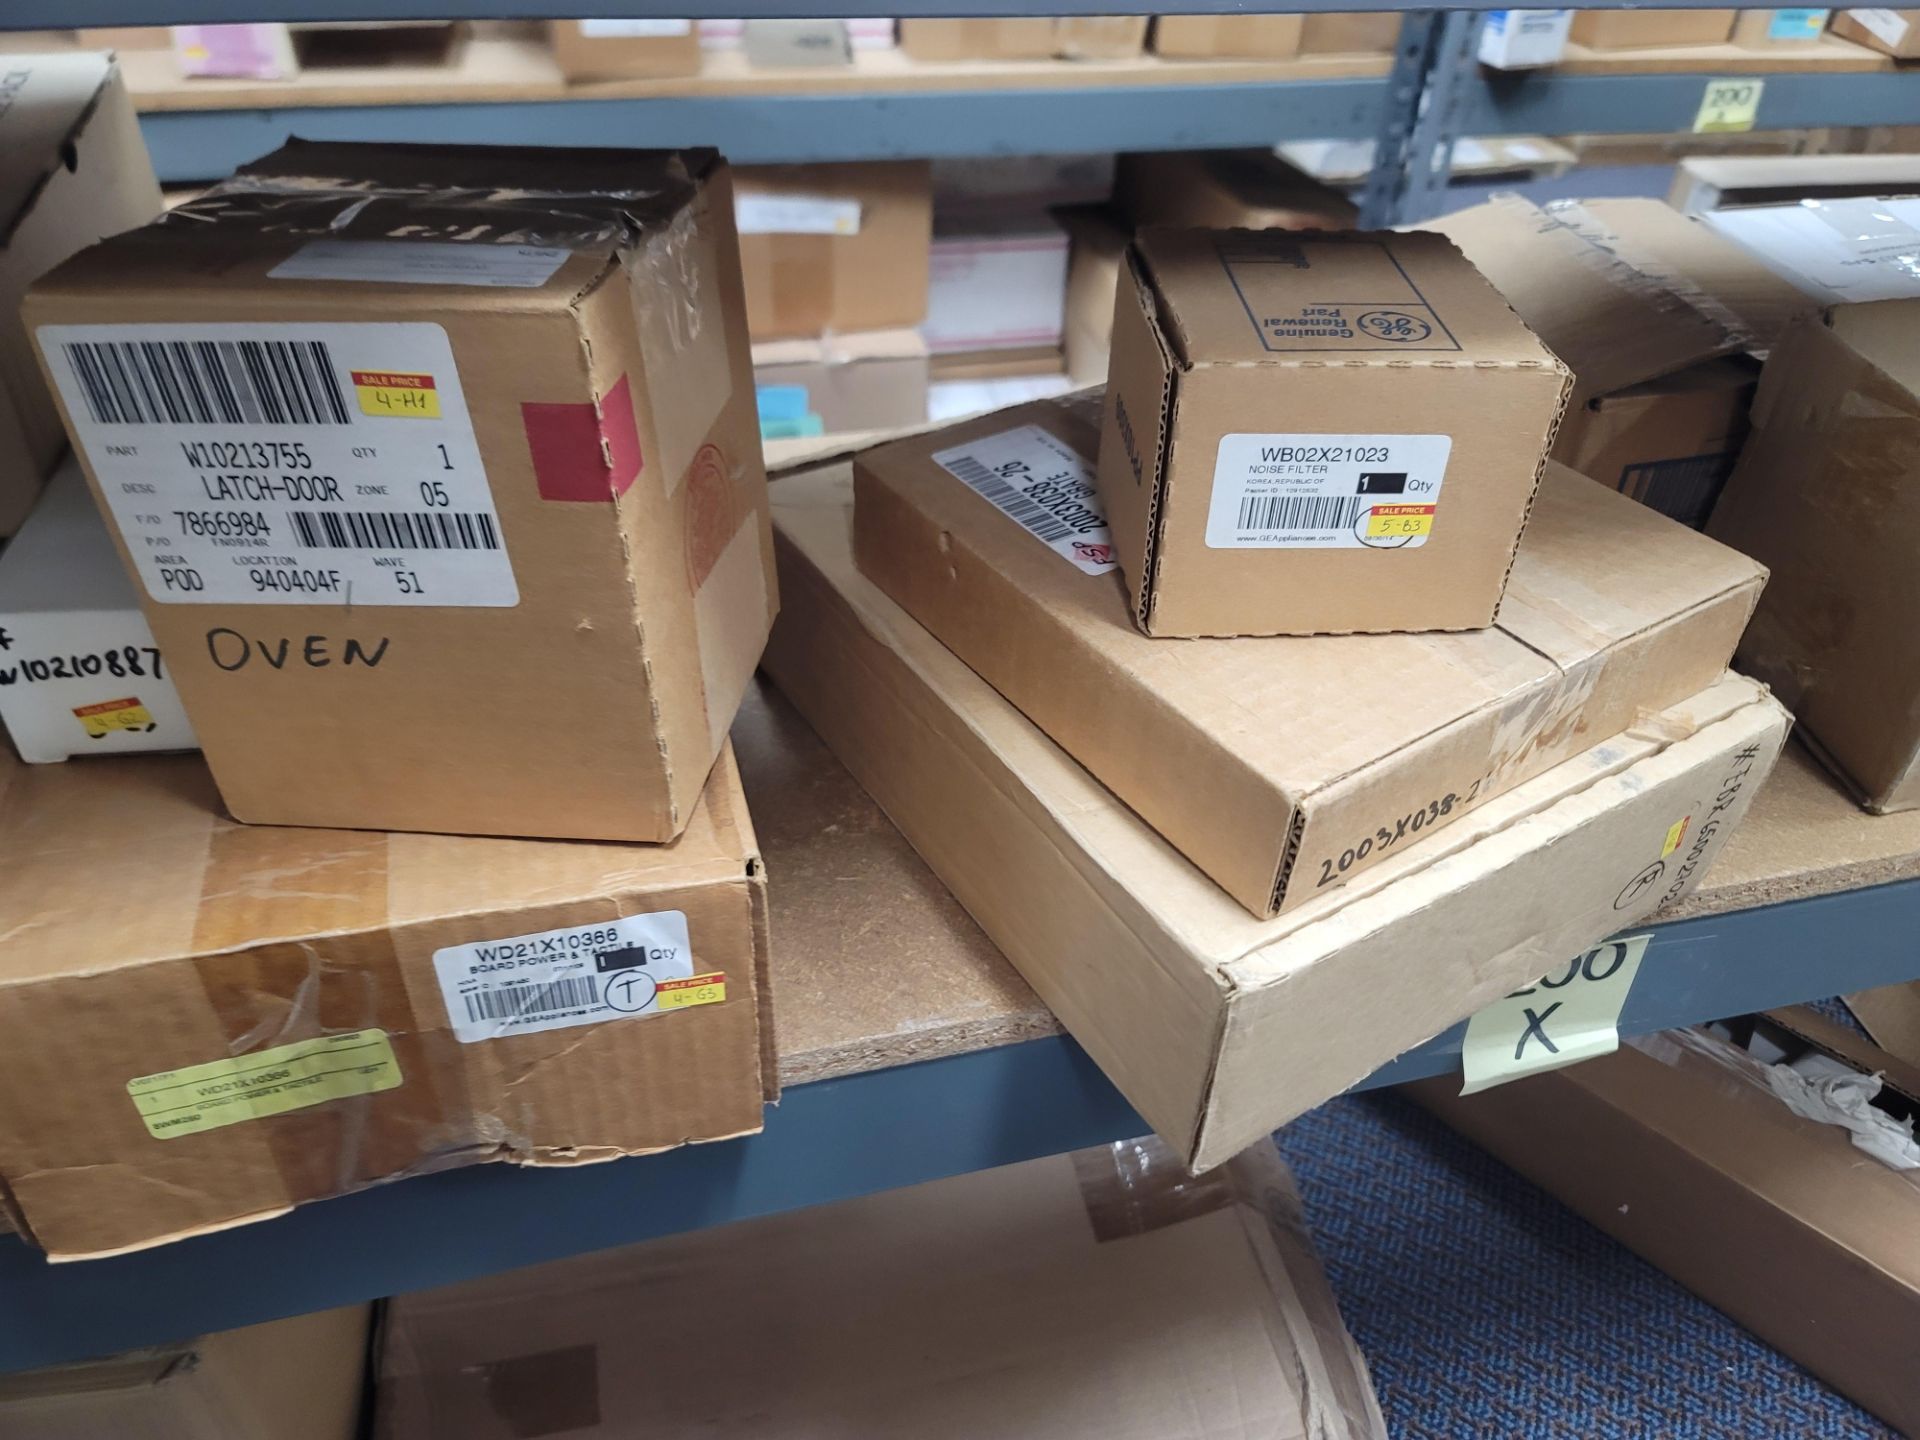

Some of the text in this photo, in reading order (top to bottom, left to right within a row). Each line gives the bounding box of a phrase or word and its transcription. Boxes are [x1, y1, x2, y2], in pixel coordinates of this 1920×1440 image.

[1264, 318, 1347, 329] Renewal
[1302, 308, 1341, 318] Part
[1274, 328, 1353, 339] Genuine
[362, 375, 422, 388] SALE PRICE
[106, 442, 455, 470] PART W10213755 QTY 1
[1261, 447, 1390, 463] WB02X21023
[1248, 465, 1329, 475] NOISE FILTER
[121, 475, 450, 507] DESC LATCH-DOOR ZONE 05
[1361, 475, 1434, 494] 1 Qty
[993, 461, 1108, 534] 2003X038-26
[1378, 507, 1425, 515] SALE PRICE
[173, 511, 271, 537] 7866984
[154, 555, 406, 567] AREA LOCATION WAVE
[160, 568, 425, 594] POD 940404F 51
[205, 628, 390, 671] OVEN
[1317, 770, 1494, 888] 2003X038-2
[474, 928, 618, 963] WD21X10366
[650, 948, 677, 960] Qty
[469, 960, 516, 975] BOARD
[518, 952, 567, 969] POWER
[1503, 942, 1628, 999] 00
[664, 981, 688, 990] SALE
[1514, 1001, 1564, 1060] X
